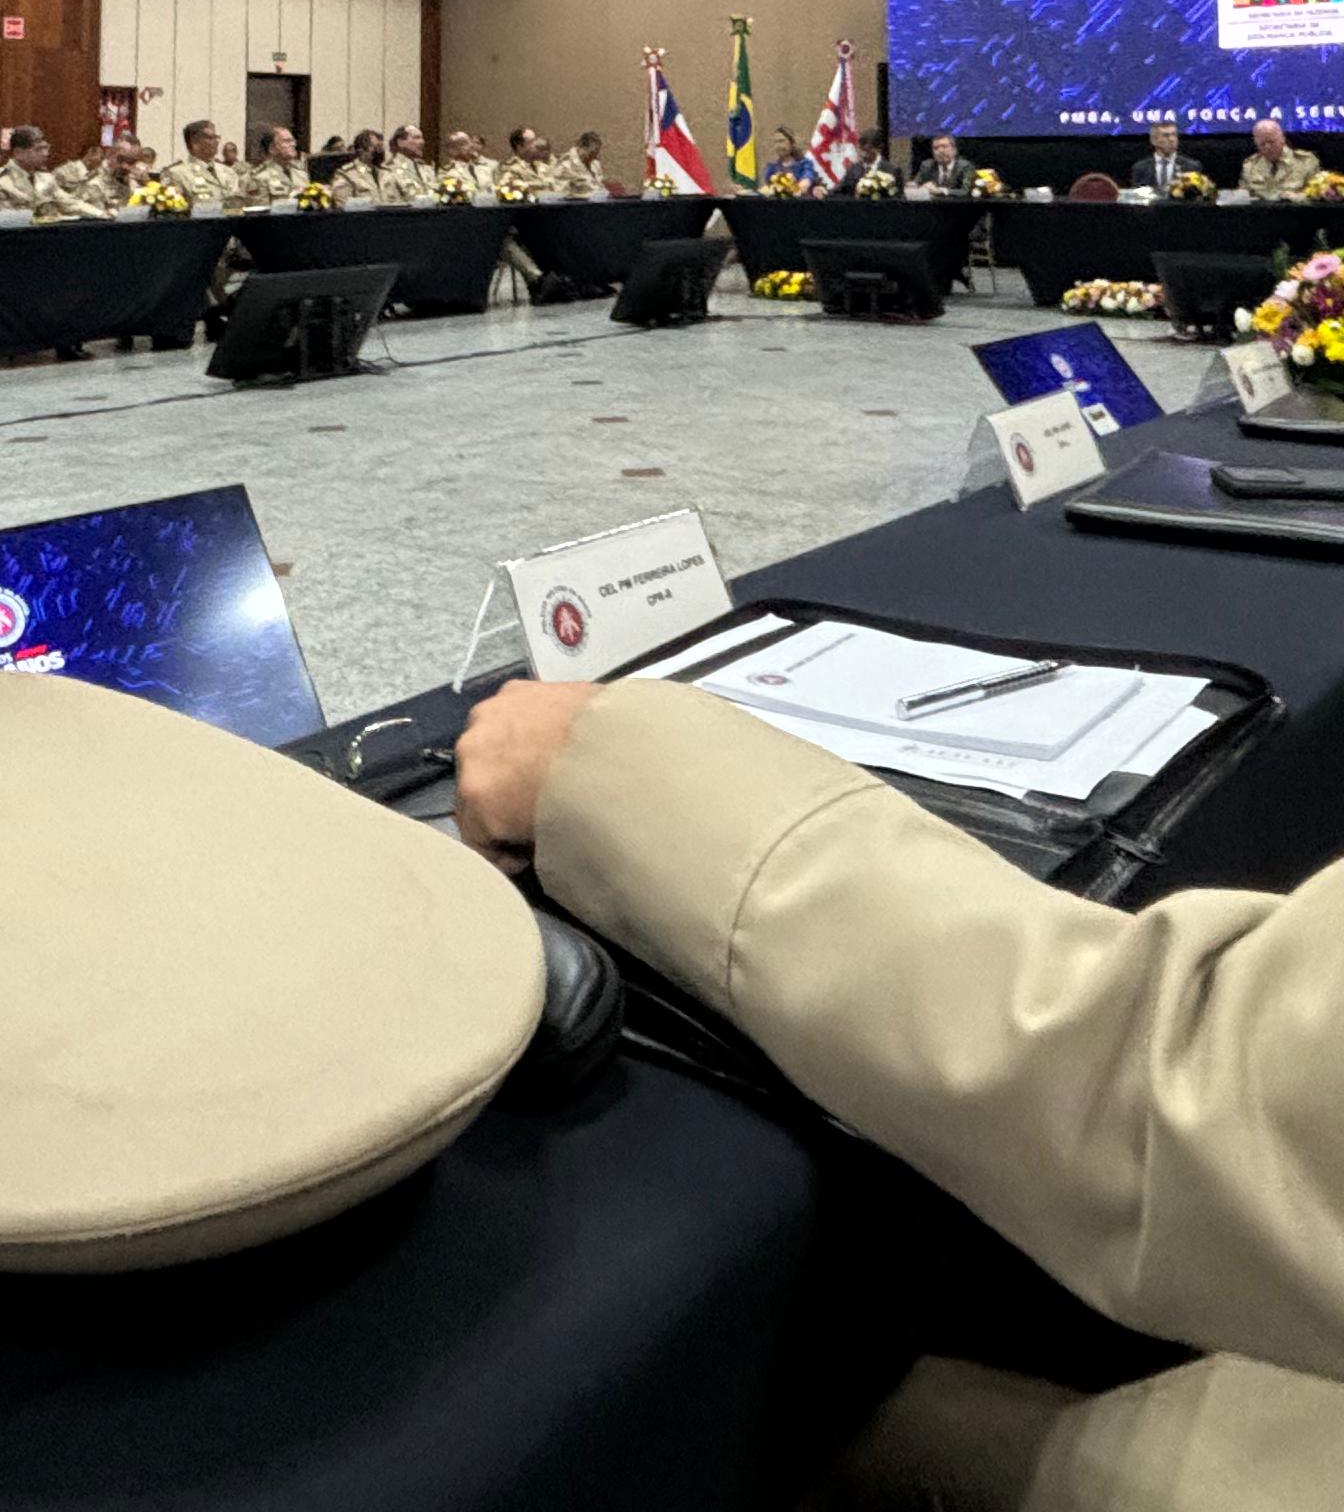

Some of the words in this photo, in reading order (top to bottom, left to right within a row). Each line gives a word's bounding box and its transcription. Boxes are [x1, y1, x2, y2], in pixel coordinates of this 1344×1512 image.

[1132, 110, 1176, 123] UMA
[1187, 106, 1256, 123] FORÇA
[1270, 105, 1283, 119] A
